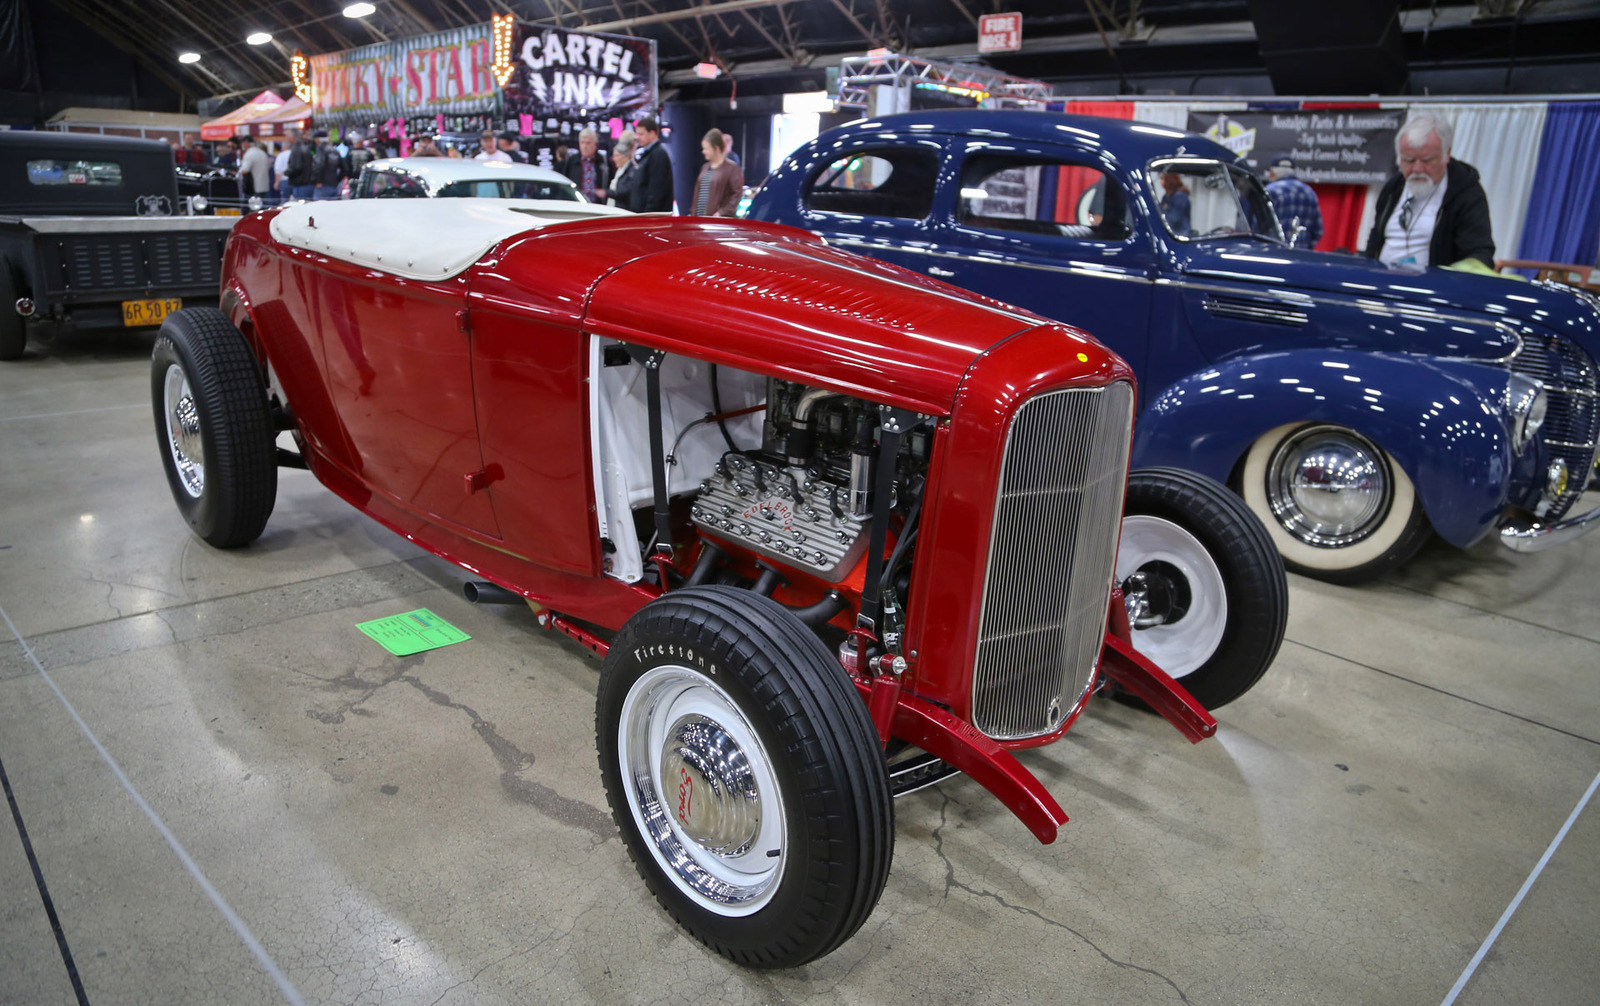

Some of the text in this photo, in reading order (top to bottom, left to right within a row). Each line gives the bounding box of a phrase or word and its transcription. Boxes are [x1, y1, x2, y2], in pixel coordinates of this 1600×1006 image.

[985, 17, 1015, 33] FIRE
[981, 33, 1007, 49] HOSE
[521, 33, 633, 82] CARTEL
[316, 38, 494, 114] PINKY STAR
[551, 71, 608, 107] INK
[1310, 114, 1333, 129] Parts
[1335, 114, 1344, 129] &
[126, 304, 143, 320] 6R
[146, 302, 162, 318] 50
[743, 501, 793, 532] EDELBROCK
[634, 644, 716, 674] Firestone
[679, 768, 693, 825] Ford
